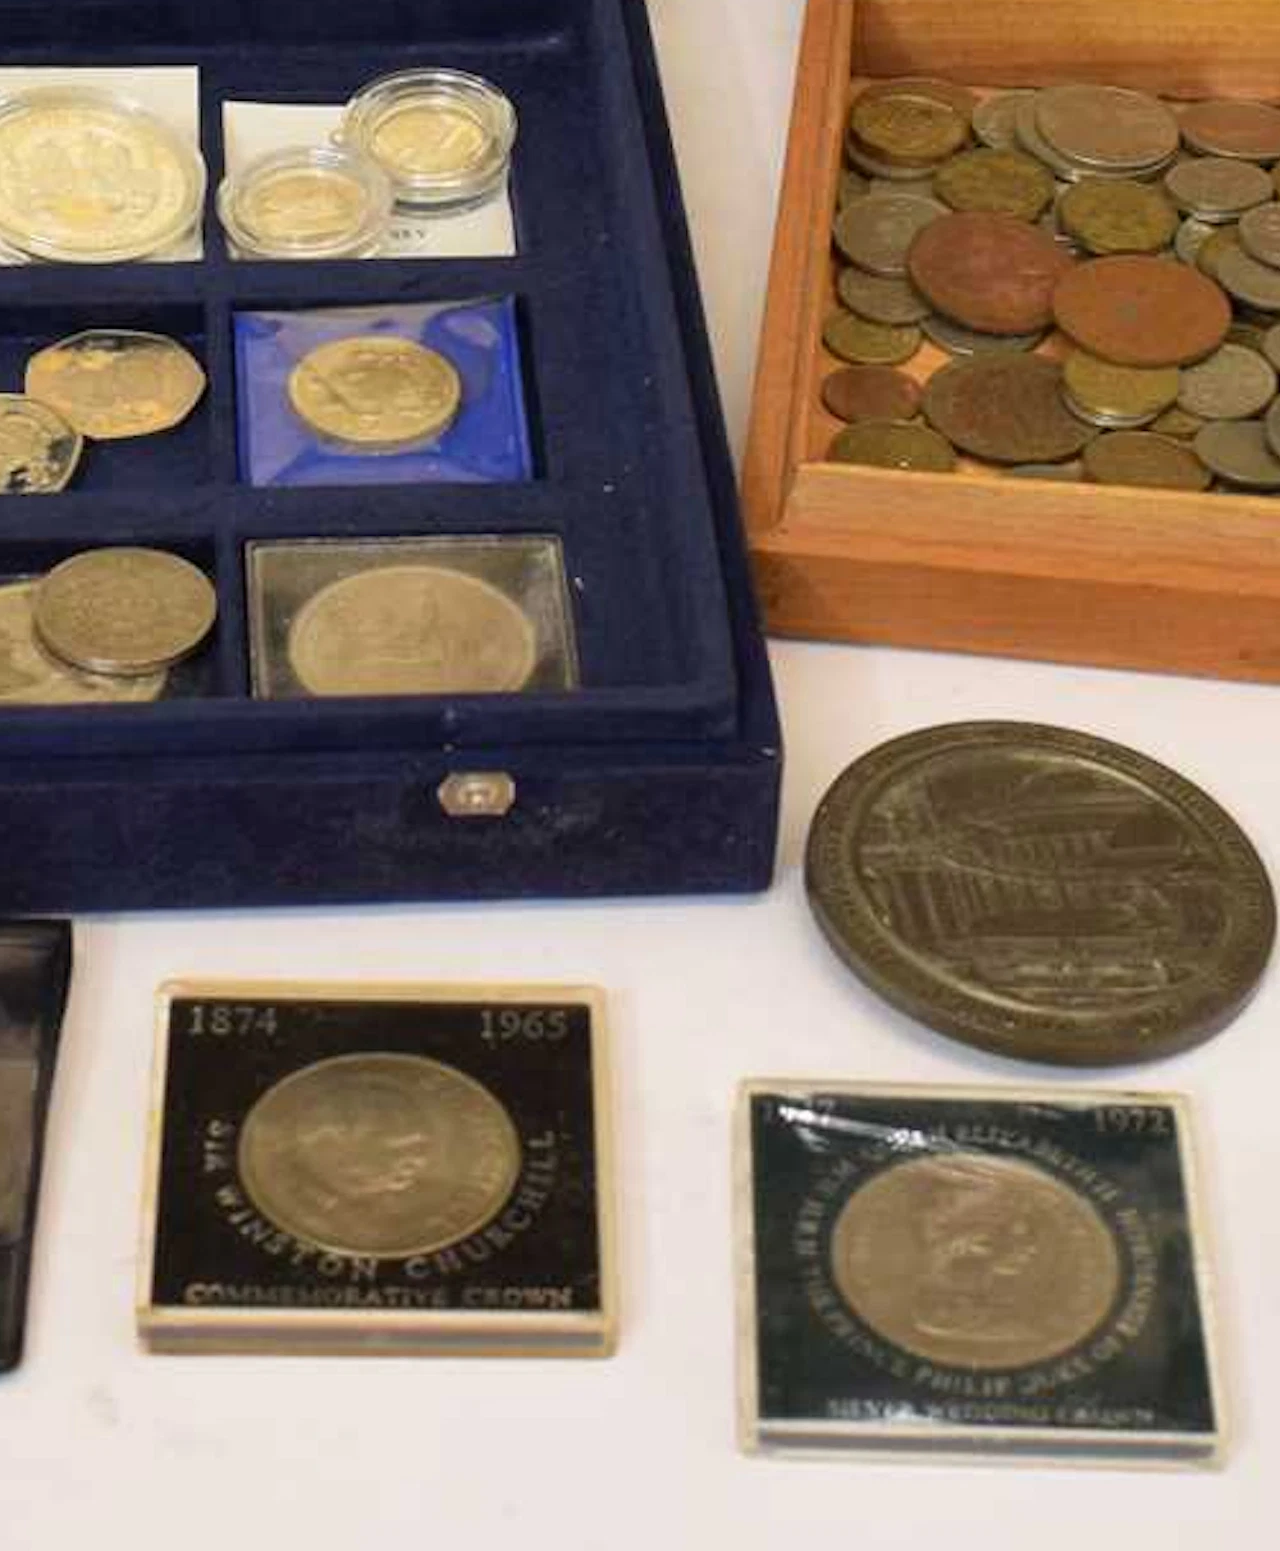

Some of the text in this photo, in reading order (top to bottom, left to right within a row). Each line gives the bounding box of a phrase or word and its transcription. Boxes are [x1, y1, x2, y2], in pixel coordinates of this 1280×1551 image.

[187, 1006, 569, 1040] 1874 1965
[1094, 1107, 1172, 1135] 1972
[203, 1119, 557, 1278] SIR WINSTON CHURCHILL
[184, 1281, 573, 1310] COMMEMORATIVE CROWN
